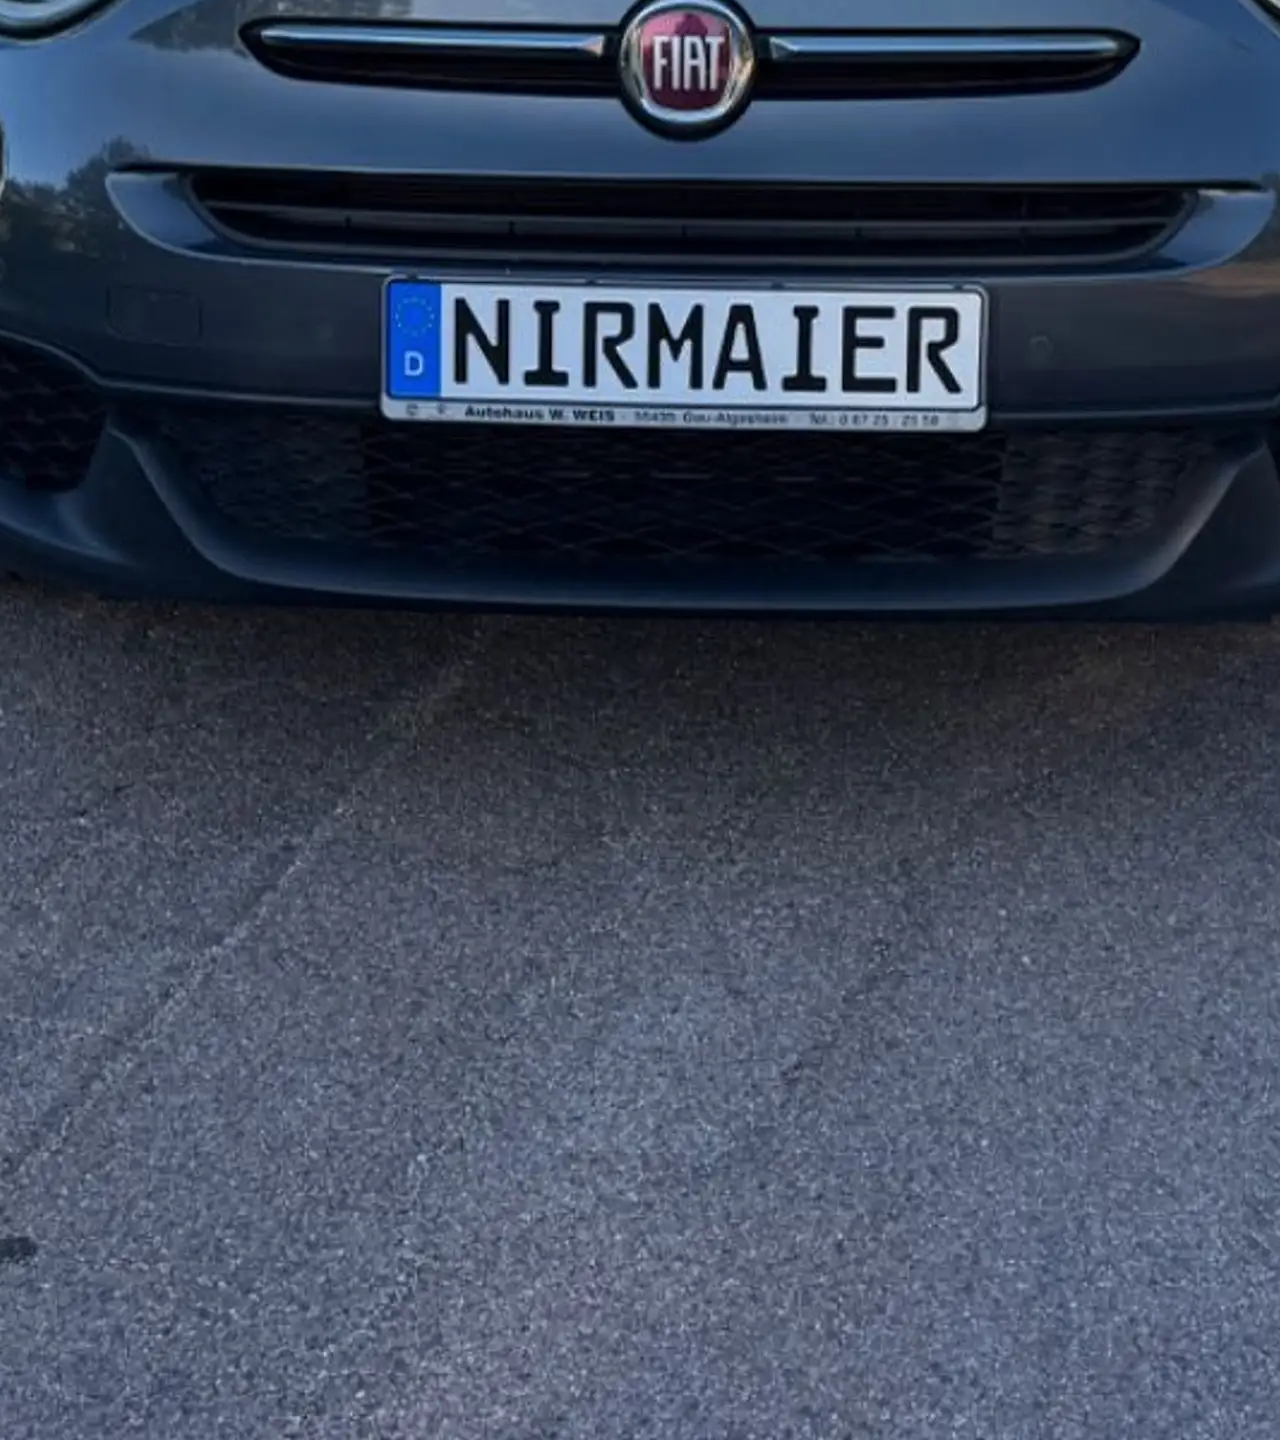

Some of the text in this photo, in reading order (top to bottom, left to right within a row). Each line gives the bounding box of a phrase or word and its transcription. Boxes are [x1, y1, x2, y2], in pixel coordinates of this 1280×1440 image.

[652, 35, 725, 91] FIAT
[404, 350, 424, 377] D
[453, 296, 963, 395] NIRMAIER
[465, 404, 545, 420] Autohaus
[572, 408, 615, 422] WEIS
